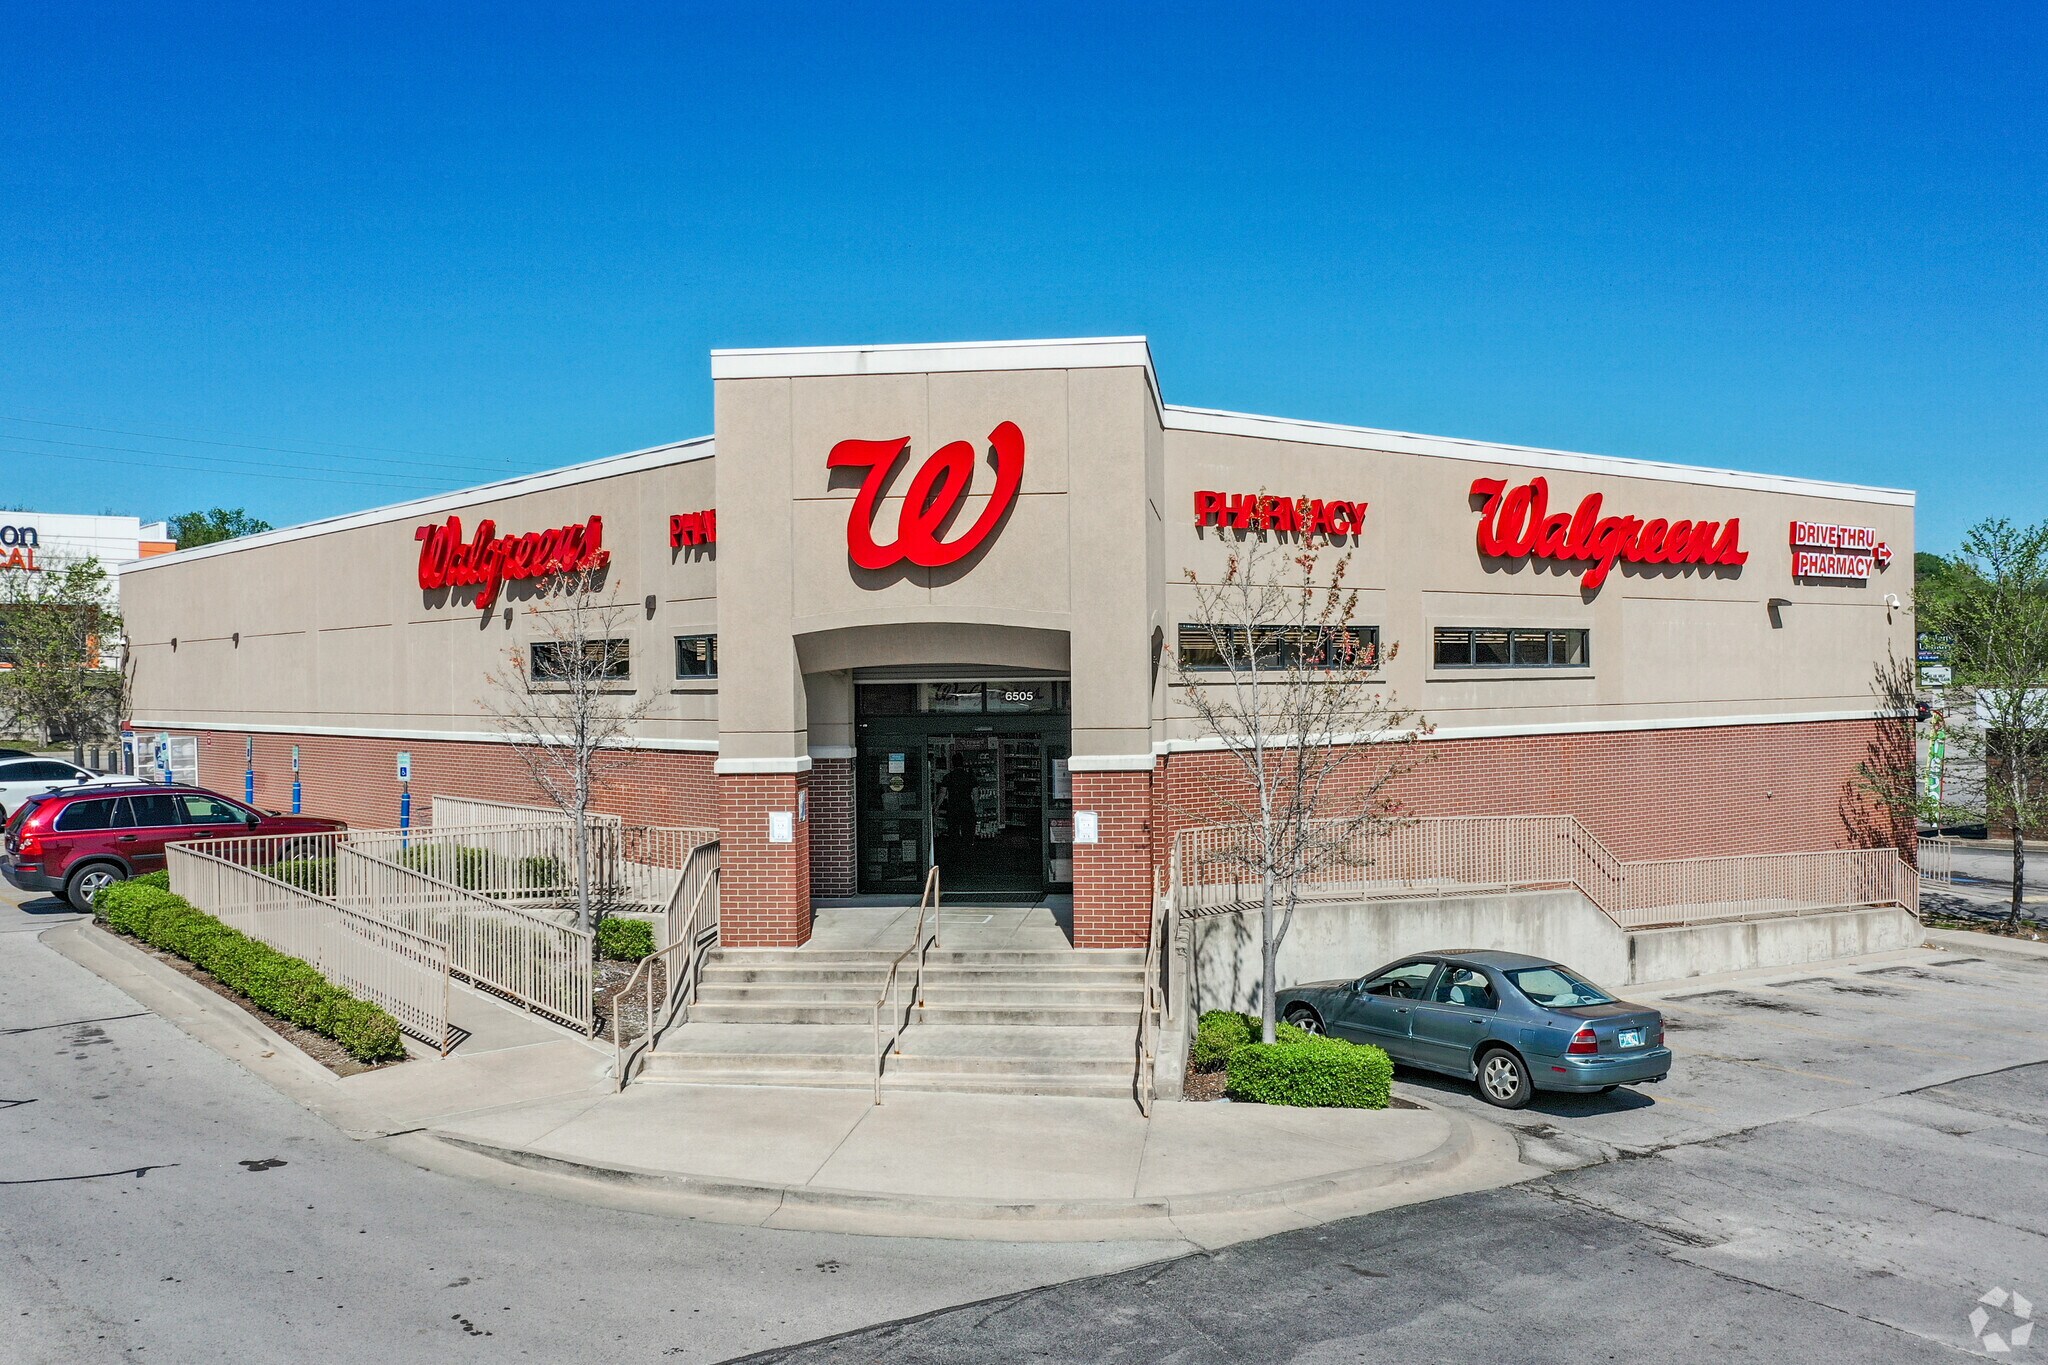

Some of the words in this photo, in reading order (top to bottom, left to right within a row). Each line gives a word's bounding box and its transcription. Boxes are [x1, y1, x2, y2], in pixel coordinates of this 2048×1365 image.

[827, 421, 1026, 570] W
[1193, 490, 1369, 537] PHARMACY
[0, 525, 40, 548] on
[1469, 475, 1750, 590] Walgreens
[1796, 523, 1838, 546] DRIVE
[1839, 527, 1876, 549] THRU
[415, 514, 611, 610] Walgreens
[1799, 553, 1874, 578] PHARMACY
[1005, 691, 1034, 701] 6505
